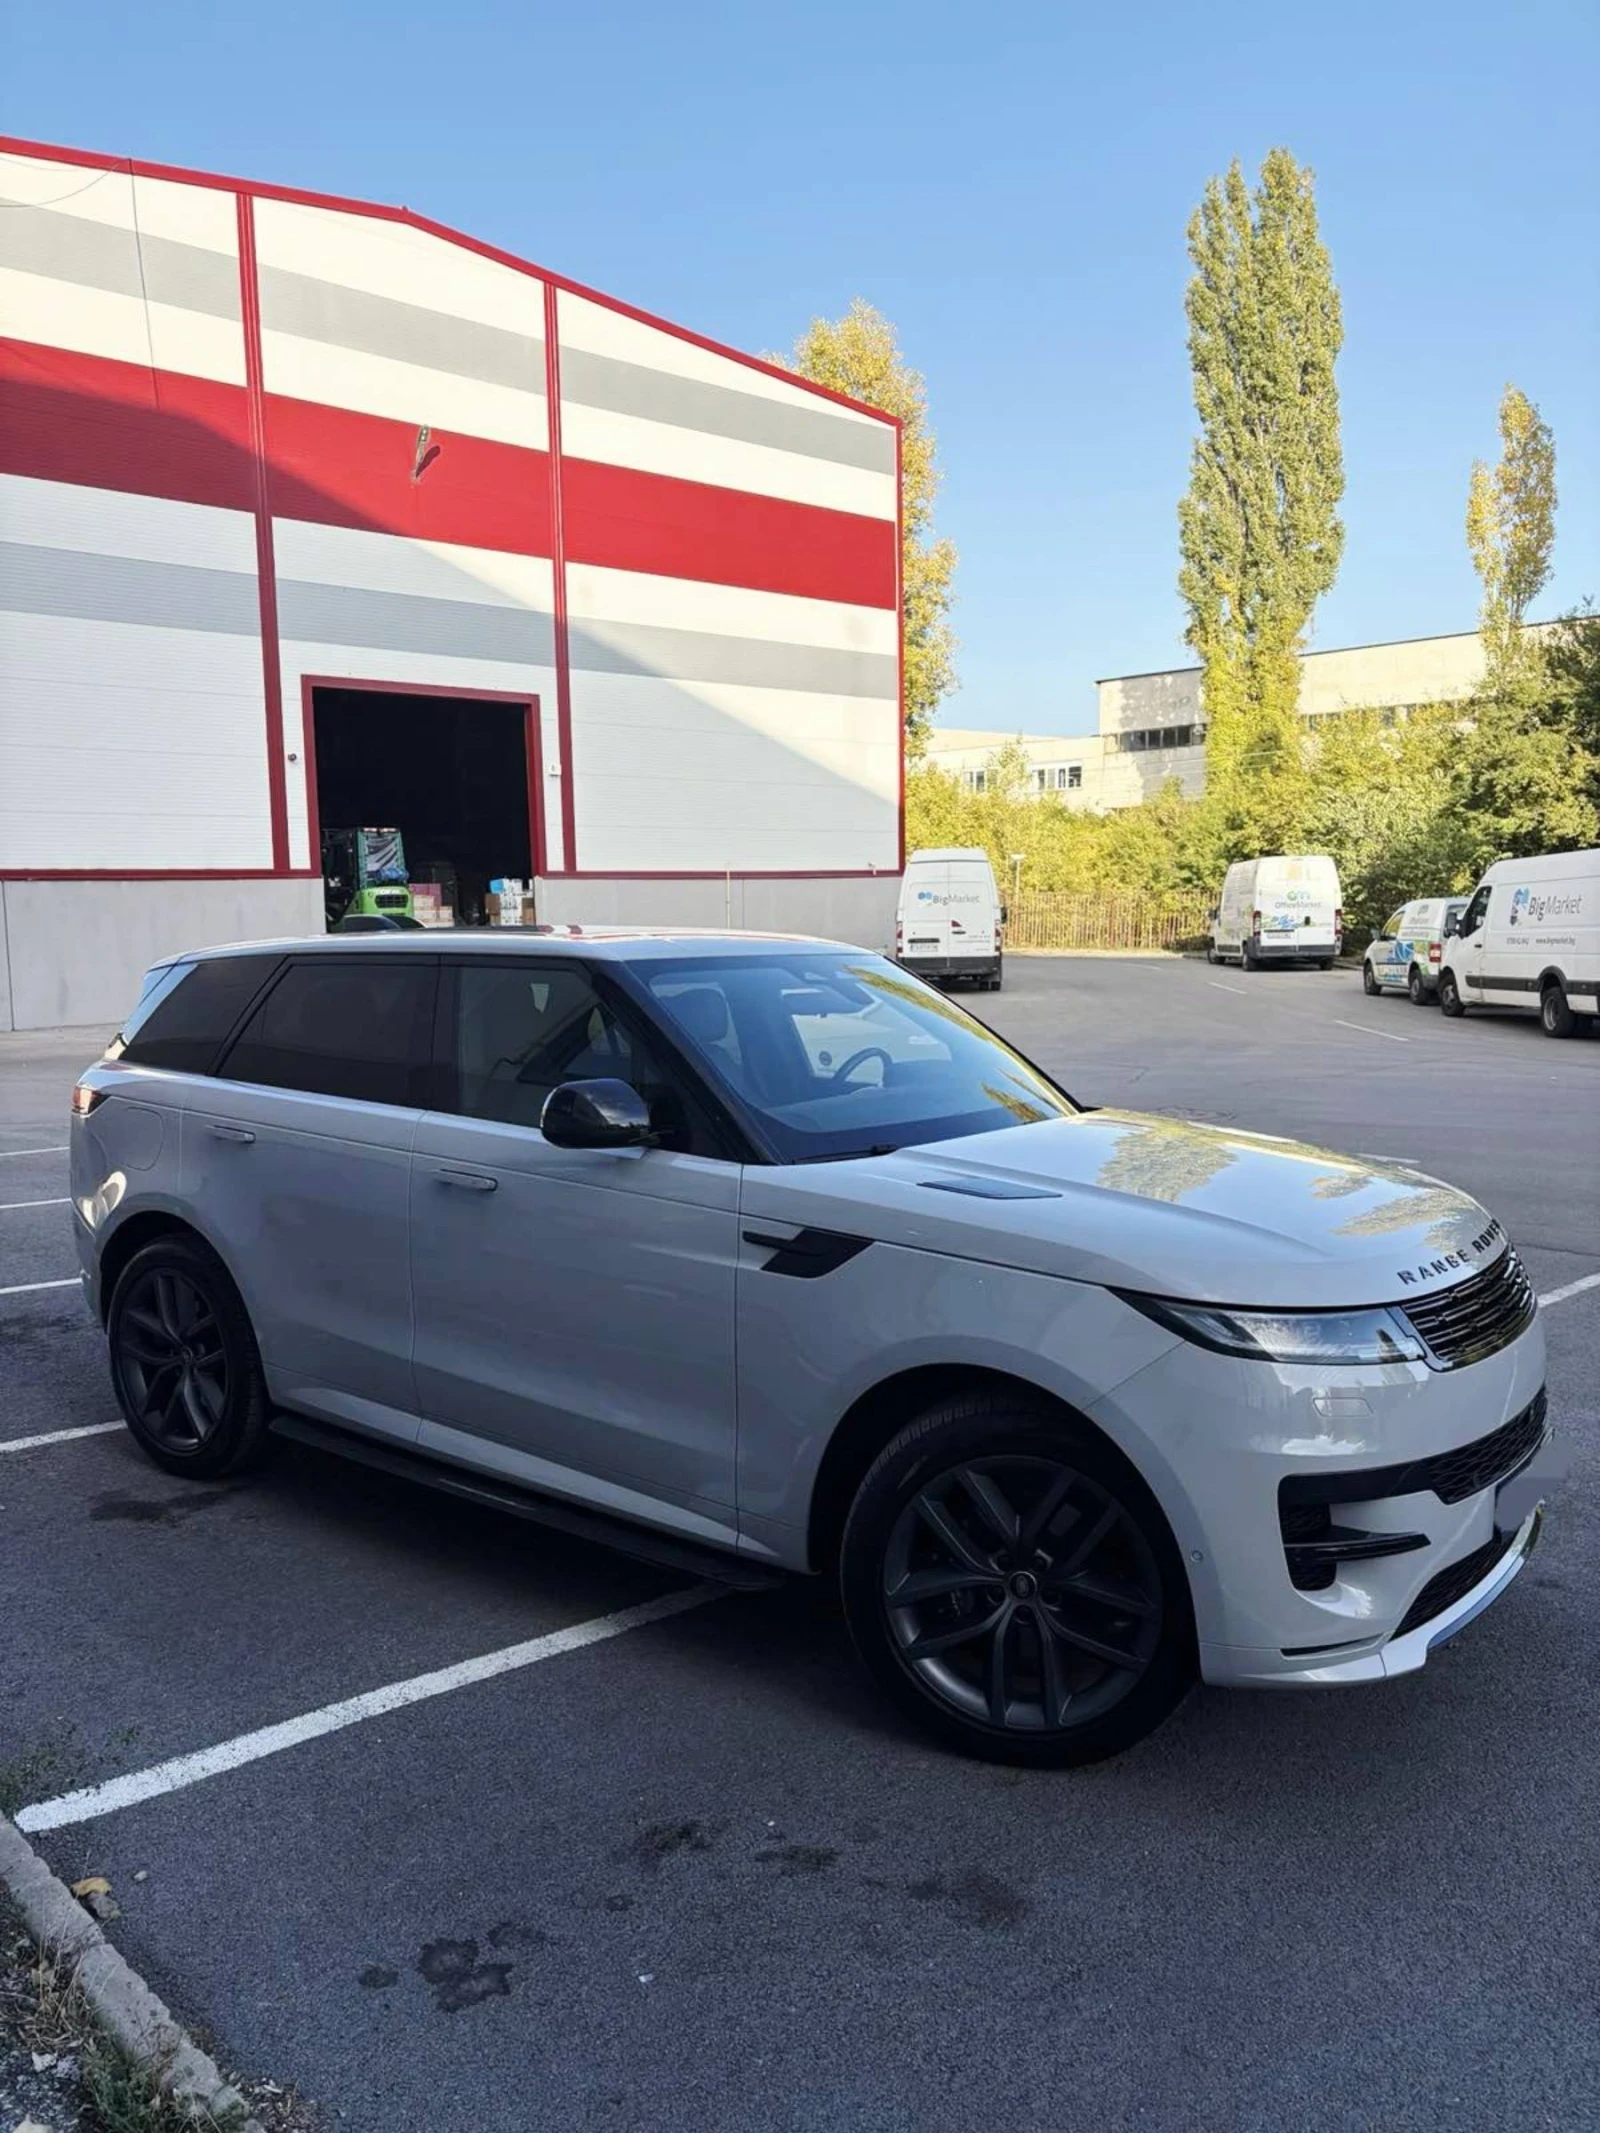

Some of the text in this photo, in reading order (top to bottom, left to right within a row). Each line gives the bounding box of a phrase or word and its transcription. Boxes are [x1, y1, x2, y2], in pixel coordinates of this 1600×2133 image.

[932, 894, 980, 906] BigMarket
[1528, 895, 1582, 921] BigMarket
[1397, 1249, 1470, 1285] RANGE
